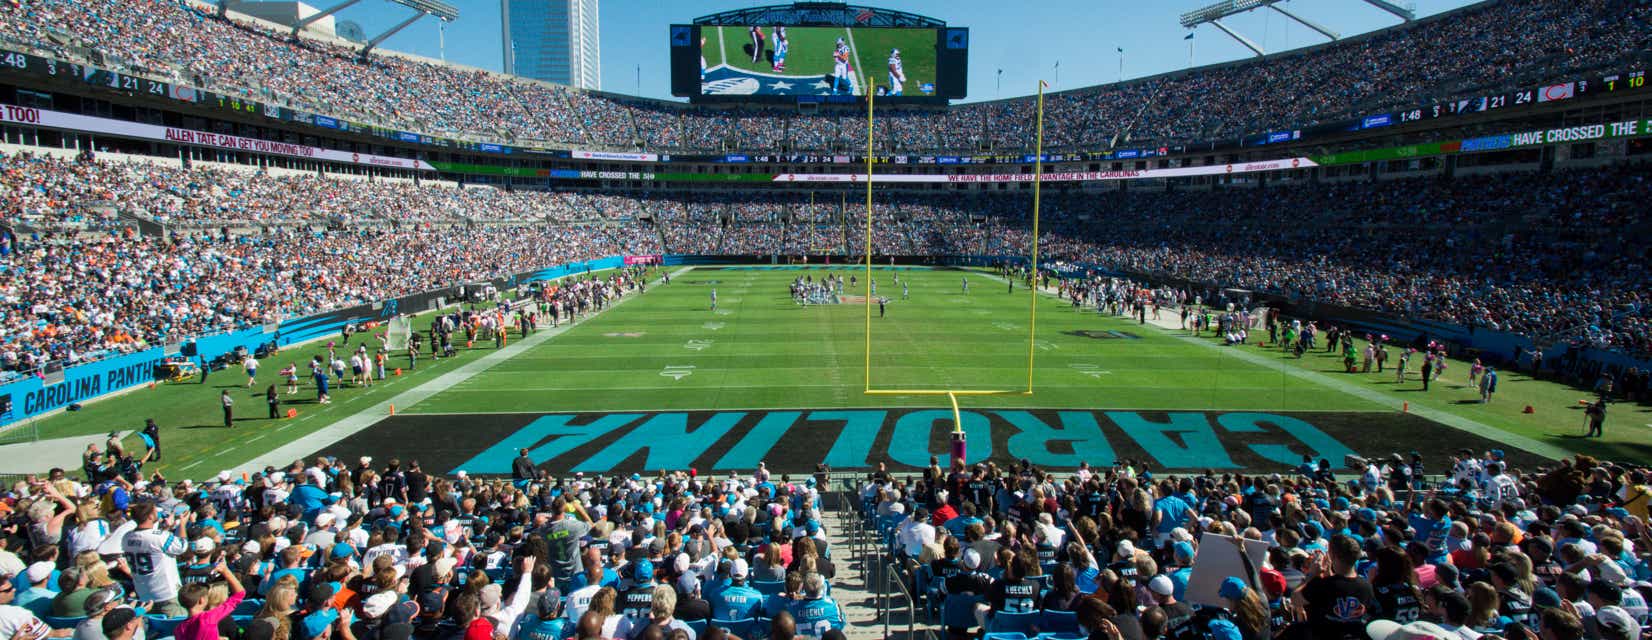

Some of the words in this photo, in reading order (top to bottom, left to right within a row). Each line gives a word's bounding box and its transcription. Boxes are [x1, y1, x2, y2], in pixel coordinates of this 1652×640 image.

[124, 76, 138, 90] 21
[149, 81, 163, 95] 24
[1401, 109, 1421, 122] 1:48
[1491, 96, 1505, 108] 21
[1515, 91, 1532, 104] 24
[1629, 76, 1644, 88] 10
[8, 107, 41, 123] TOO!
[165, 128, 195, 143] ALLEN
[196, 133, 217, 146] TATE
[218, 135, 236, 147] CAN
[238, 138, 252, 150] GET
[254, 140, 269, 152] YOU
[271, 142, 298, 155] MOVING
[1513, 131, 1543, 146] HAVE
[1547, 125, 1605, 143] CROSSED
[1610, 121, 1637, 136] THE
[581, 170, 597, 178] HAVE
[599, 171, 627, 179] CROSSED
[24, 374, 100, 415] CAROLINA
[447, 411, 1358, 475] CAROLINA
[628, 594, 652, 602] PEPPERS
[725, 595, 747, 604] NEWTON
[1006, 585, 1033, 595] KUECHLY
